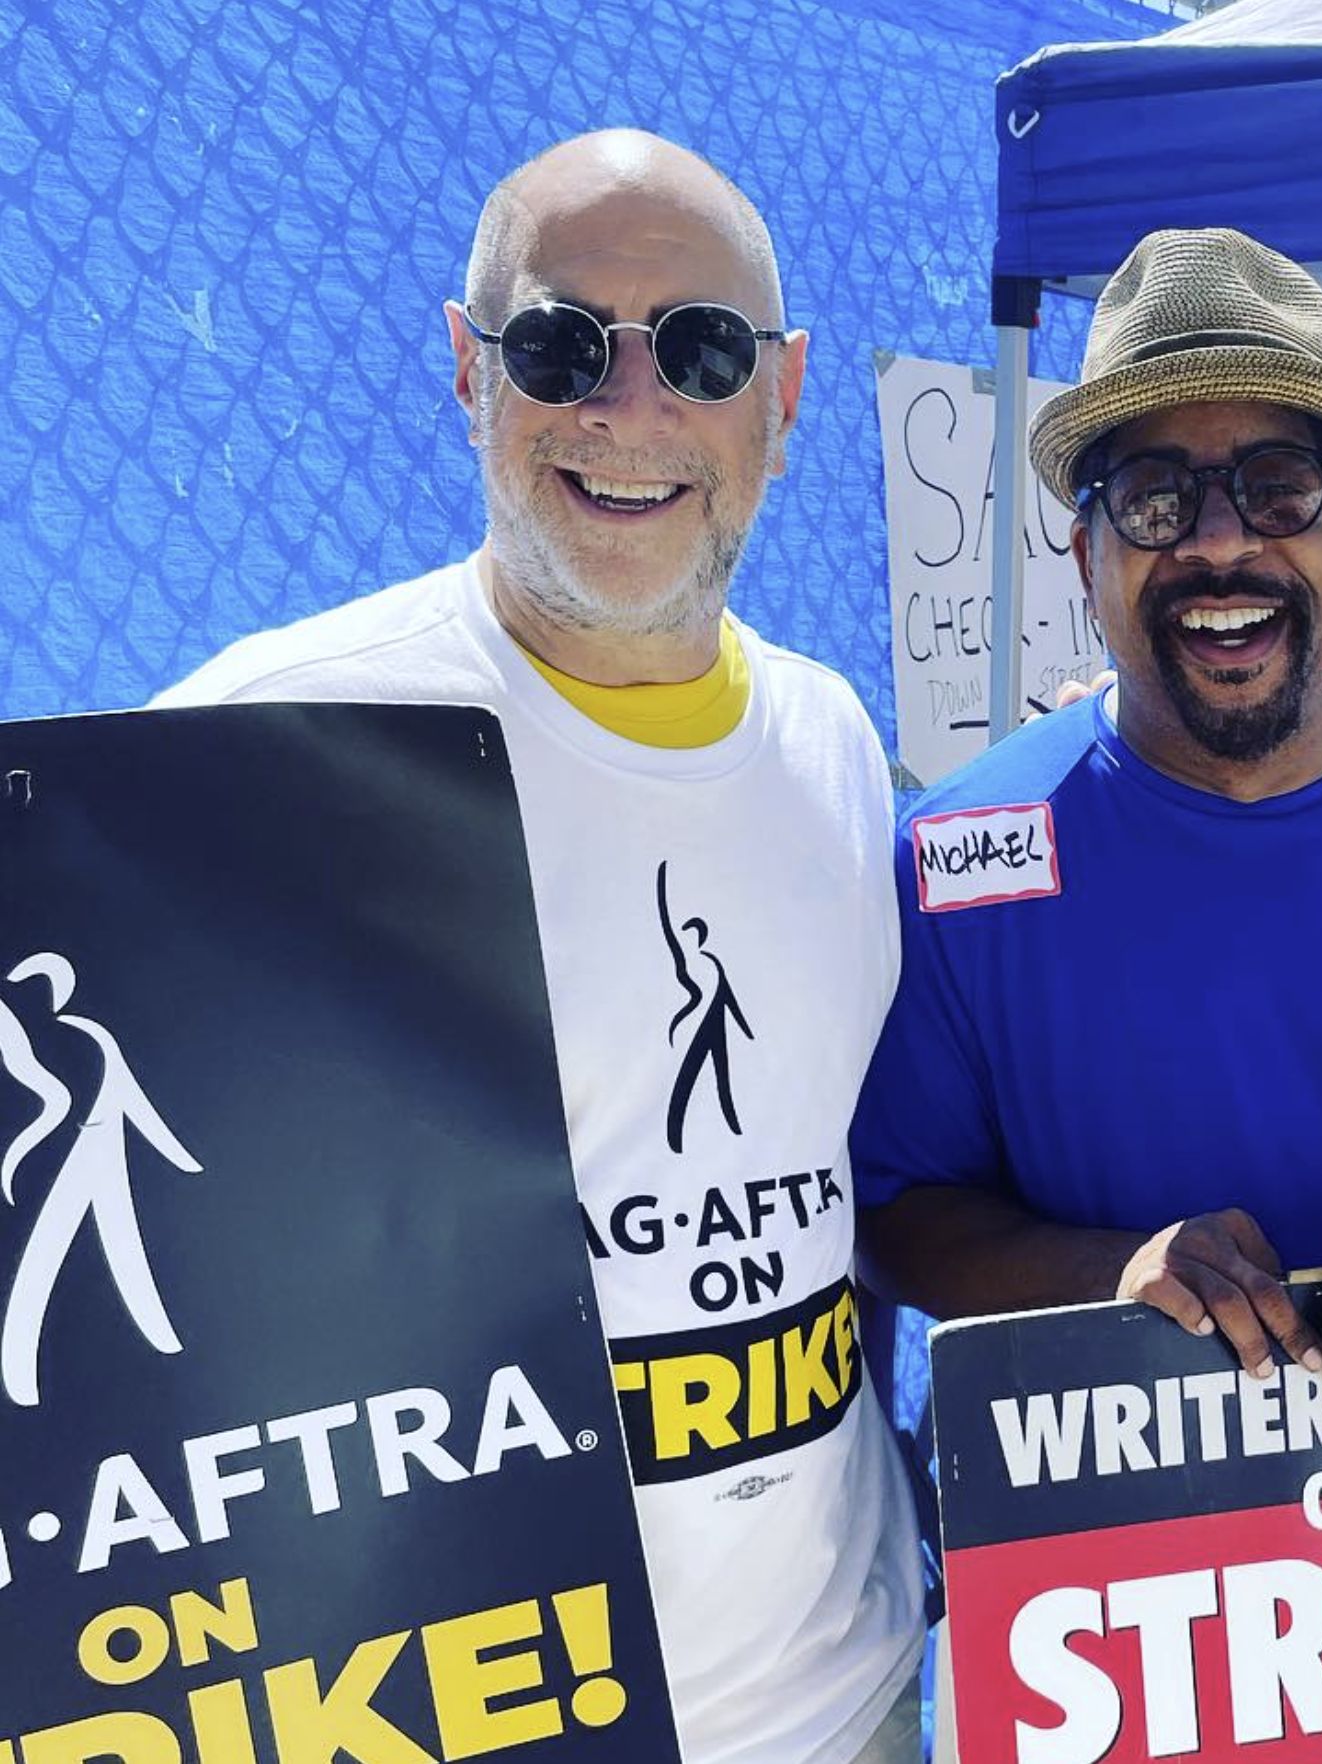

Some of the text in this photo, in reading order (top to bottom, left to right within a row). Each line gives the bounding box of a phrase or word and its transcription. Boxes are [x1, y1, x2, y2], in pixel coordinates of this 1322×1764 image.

[919, 824, 1043, 882] MICHAEL
[689, 1251, 785, 1312] ON
[78, 1577, 258, 1685] ON
